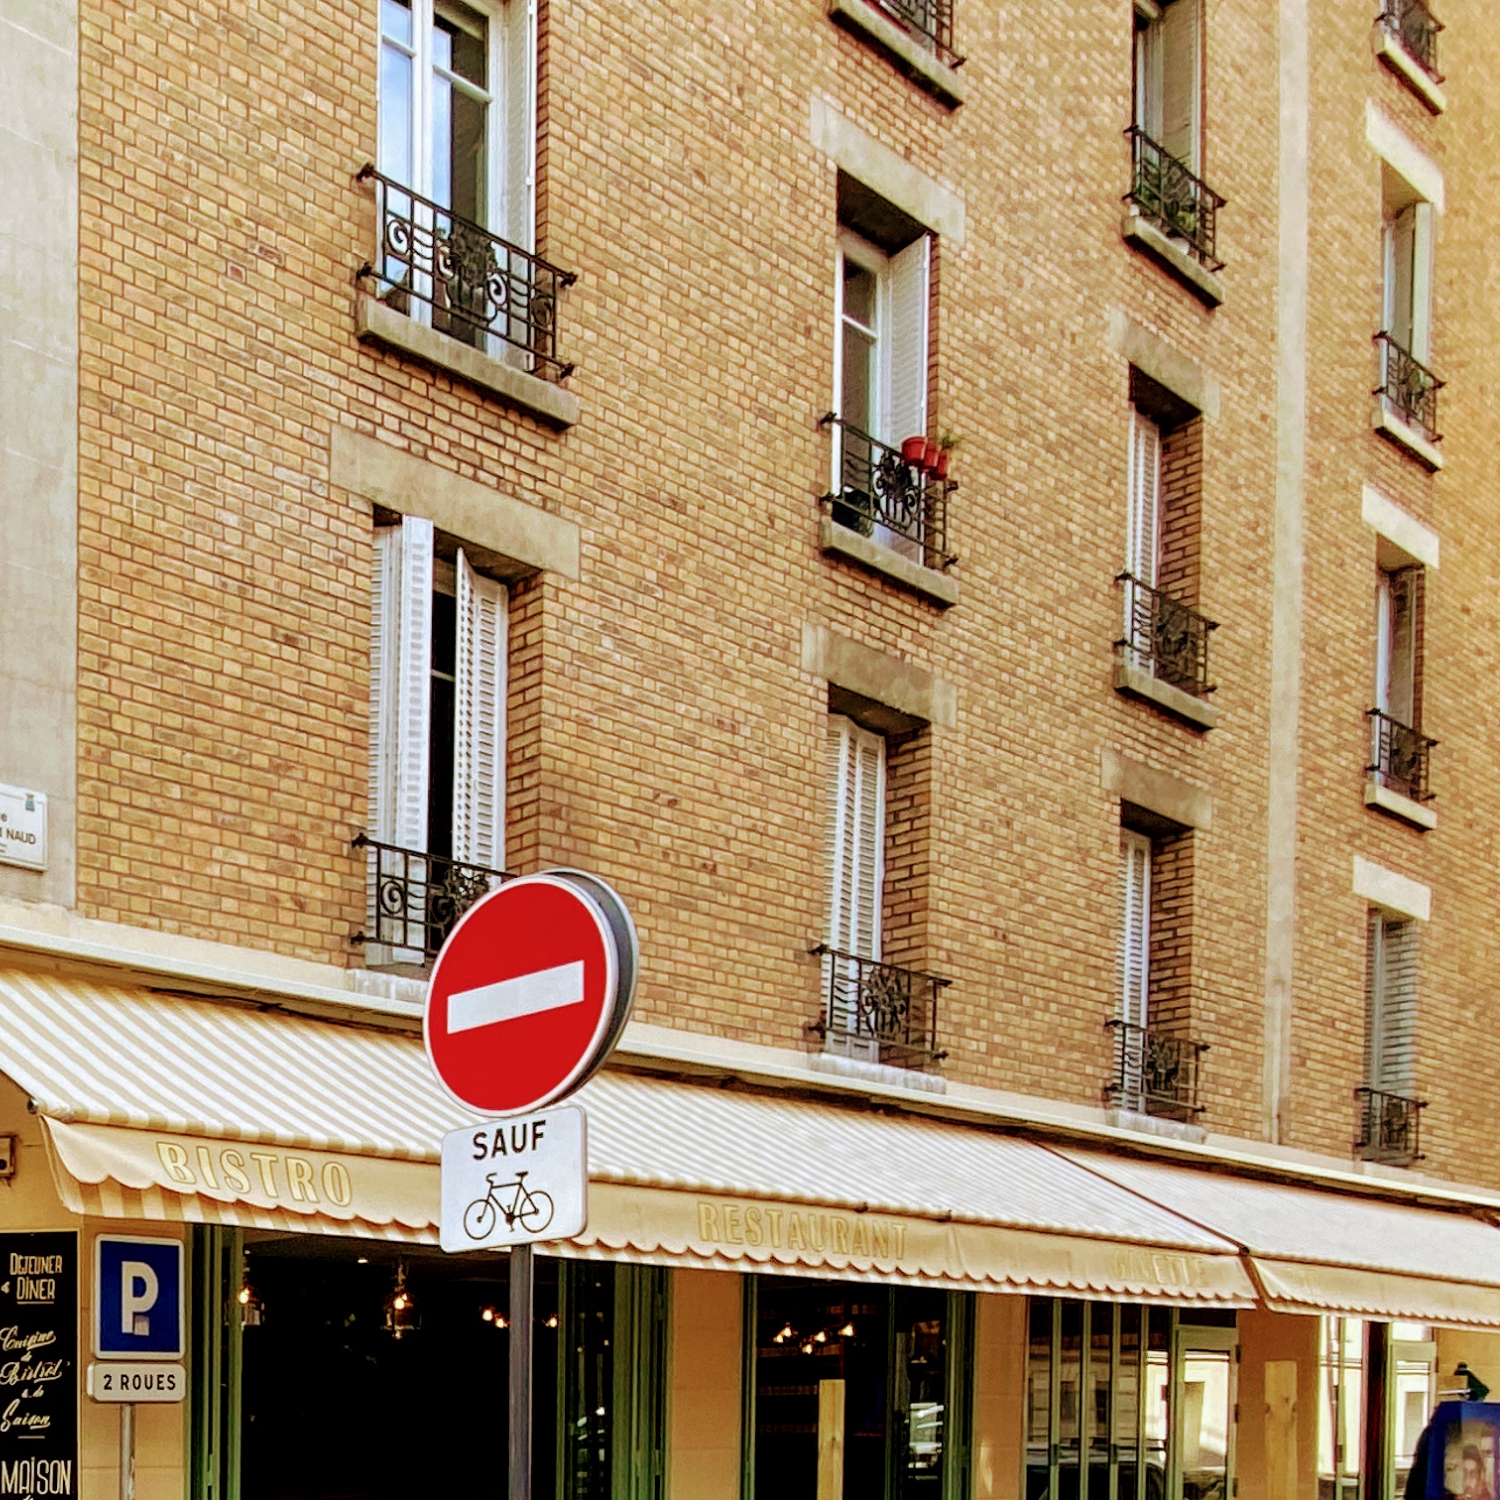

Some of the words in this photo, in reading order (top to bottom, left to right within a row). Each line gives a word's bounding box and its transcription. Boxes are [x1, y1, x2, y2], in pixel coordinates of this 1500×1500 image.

[6, 828, 36, 845] NAUD
[472, 1119, 547, 1161] SAUF
[156, 1141, 352, 1208] BISTRO
[697, 1202, 906, 1260] RESTAURANT
[121, 1260, 159, 1334] P
[103, 1374, 113, 1391] 2
[120, 1374, 176, 1391] ROUES
[0, 1398, 50, 1432] Saison
[1, 1456, 72, 1495] MAISON
